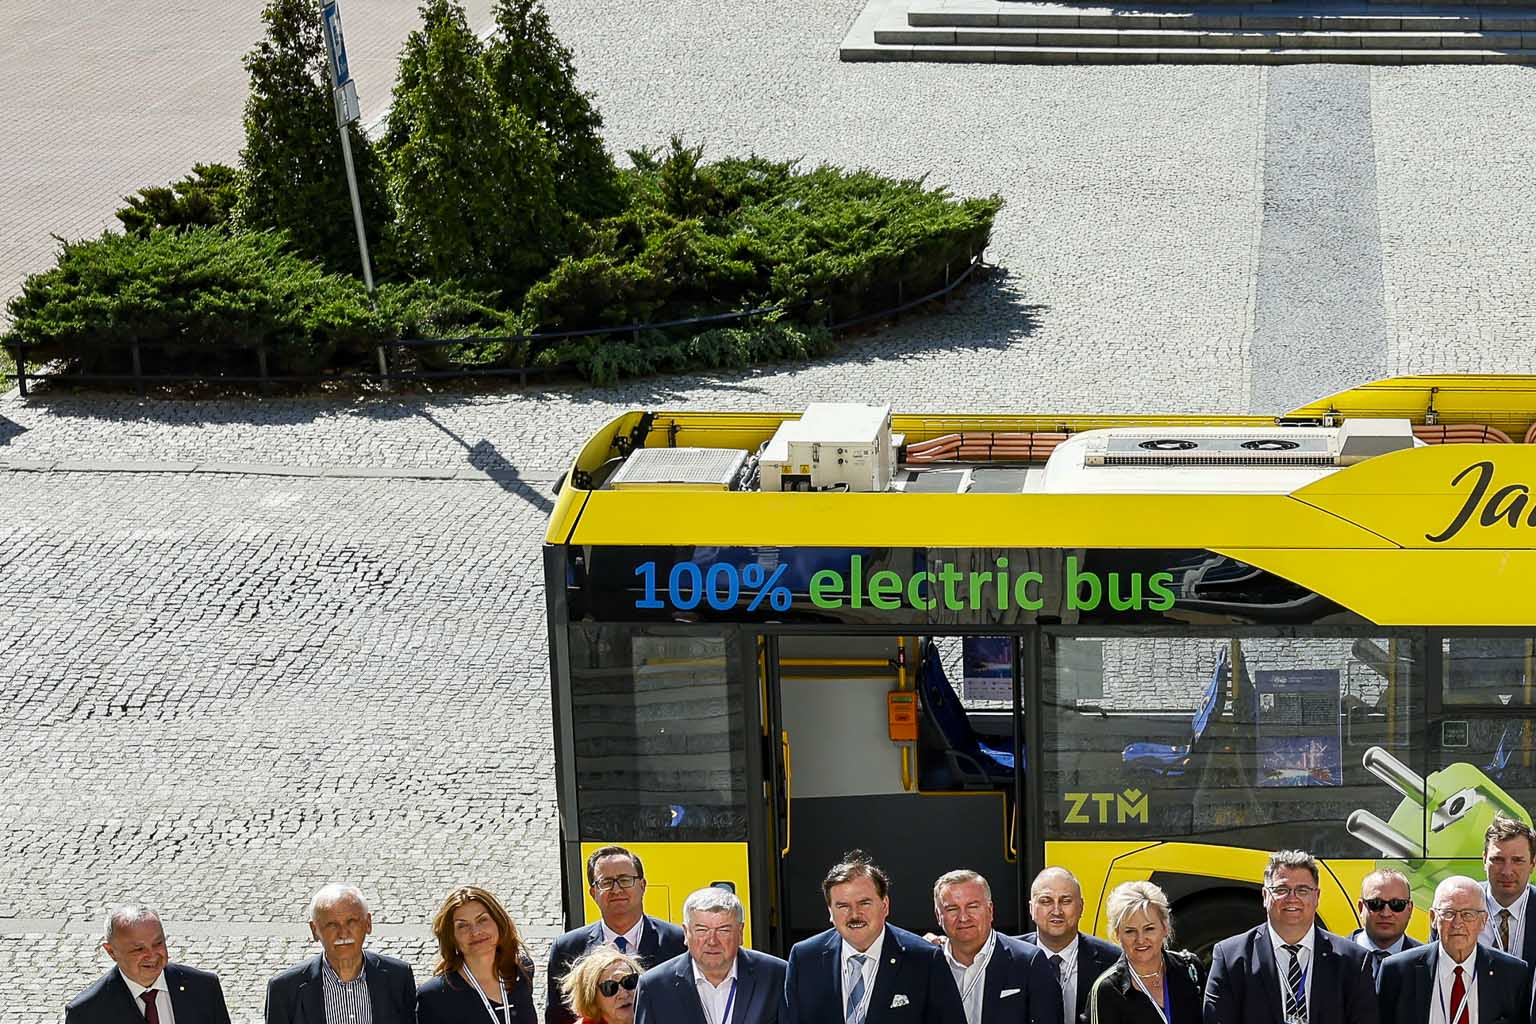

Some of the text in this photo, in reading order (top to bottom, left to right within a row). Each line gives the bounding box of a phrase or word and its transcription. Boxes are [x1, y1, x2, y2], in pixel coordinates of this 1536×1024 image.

[635, 554, 1177, 612] 100% electric bus
[1063, 788, 1149, 824] ZTM
